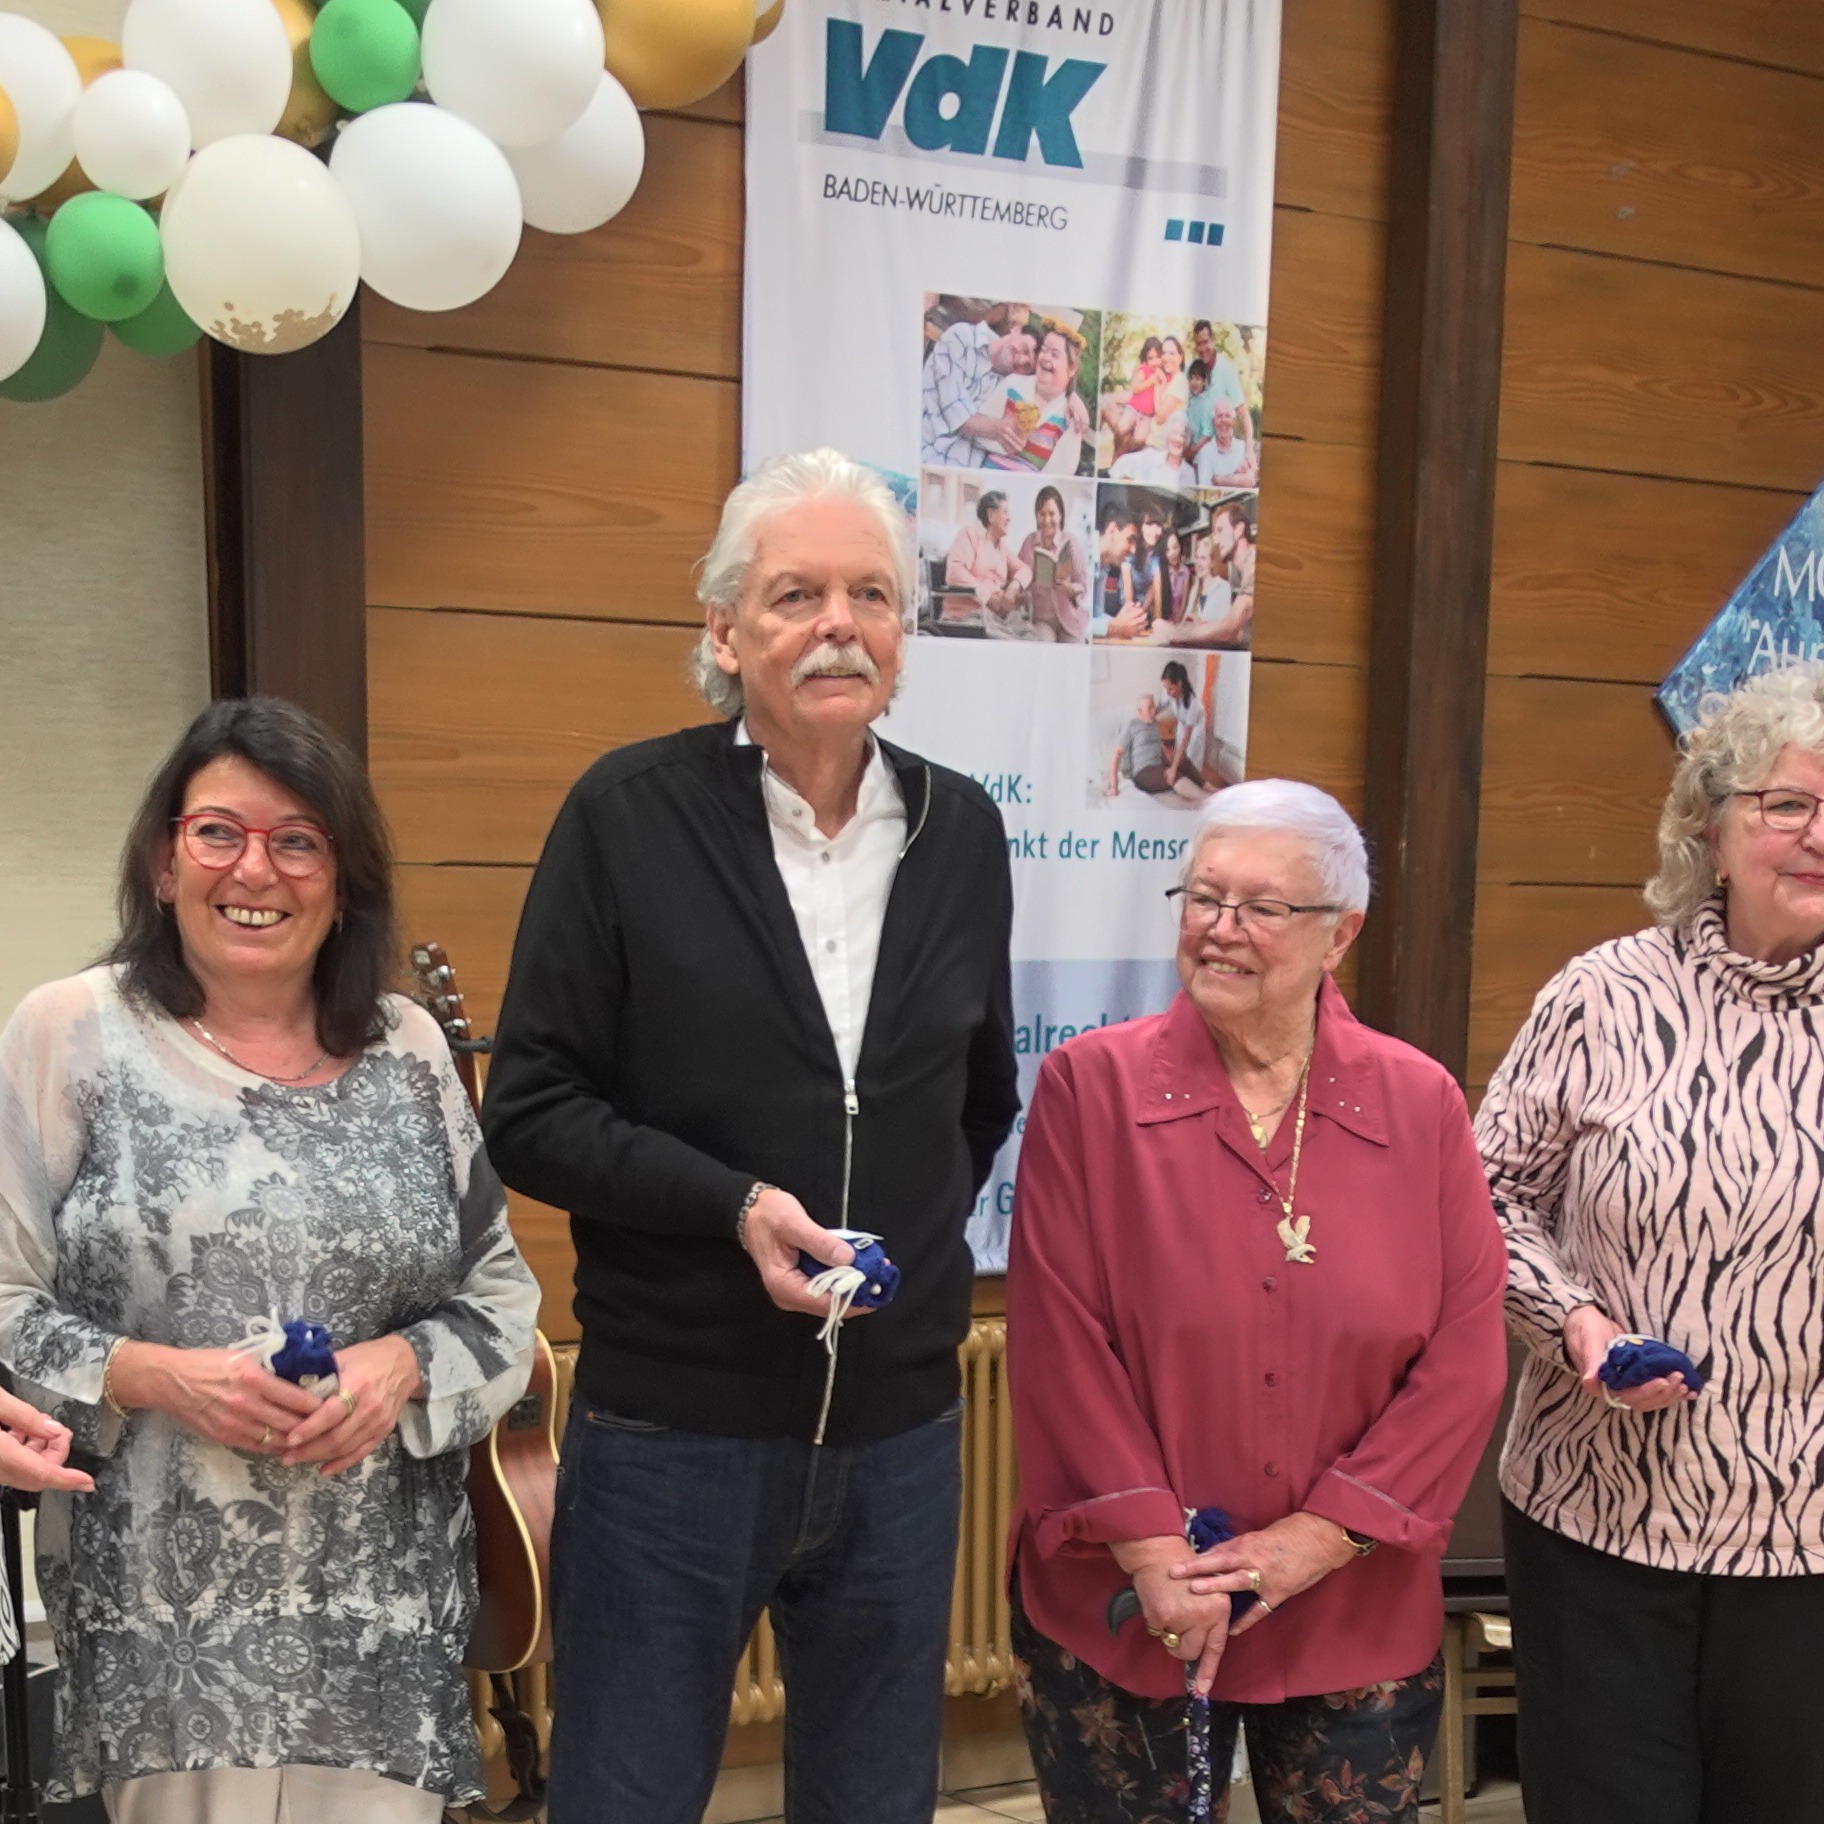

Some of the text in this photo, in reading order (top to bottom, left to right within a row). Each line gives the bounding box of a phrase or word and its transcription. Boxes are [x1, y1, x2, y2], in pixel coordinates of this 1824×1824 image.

[823, 17, 1108, 168] VdK
[823, 173, 1068, 230] BADEN-WÜRTTEMBERG
[1008, 829, 1190, 860] nkt der Mensc
